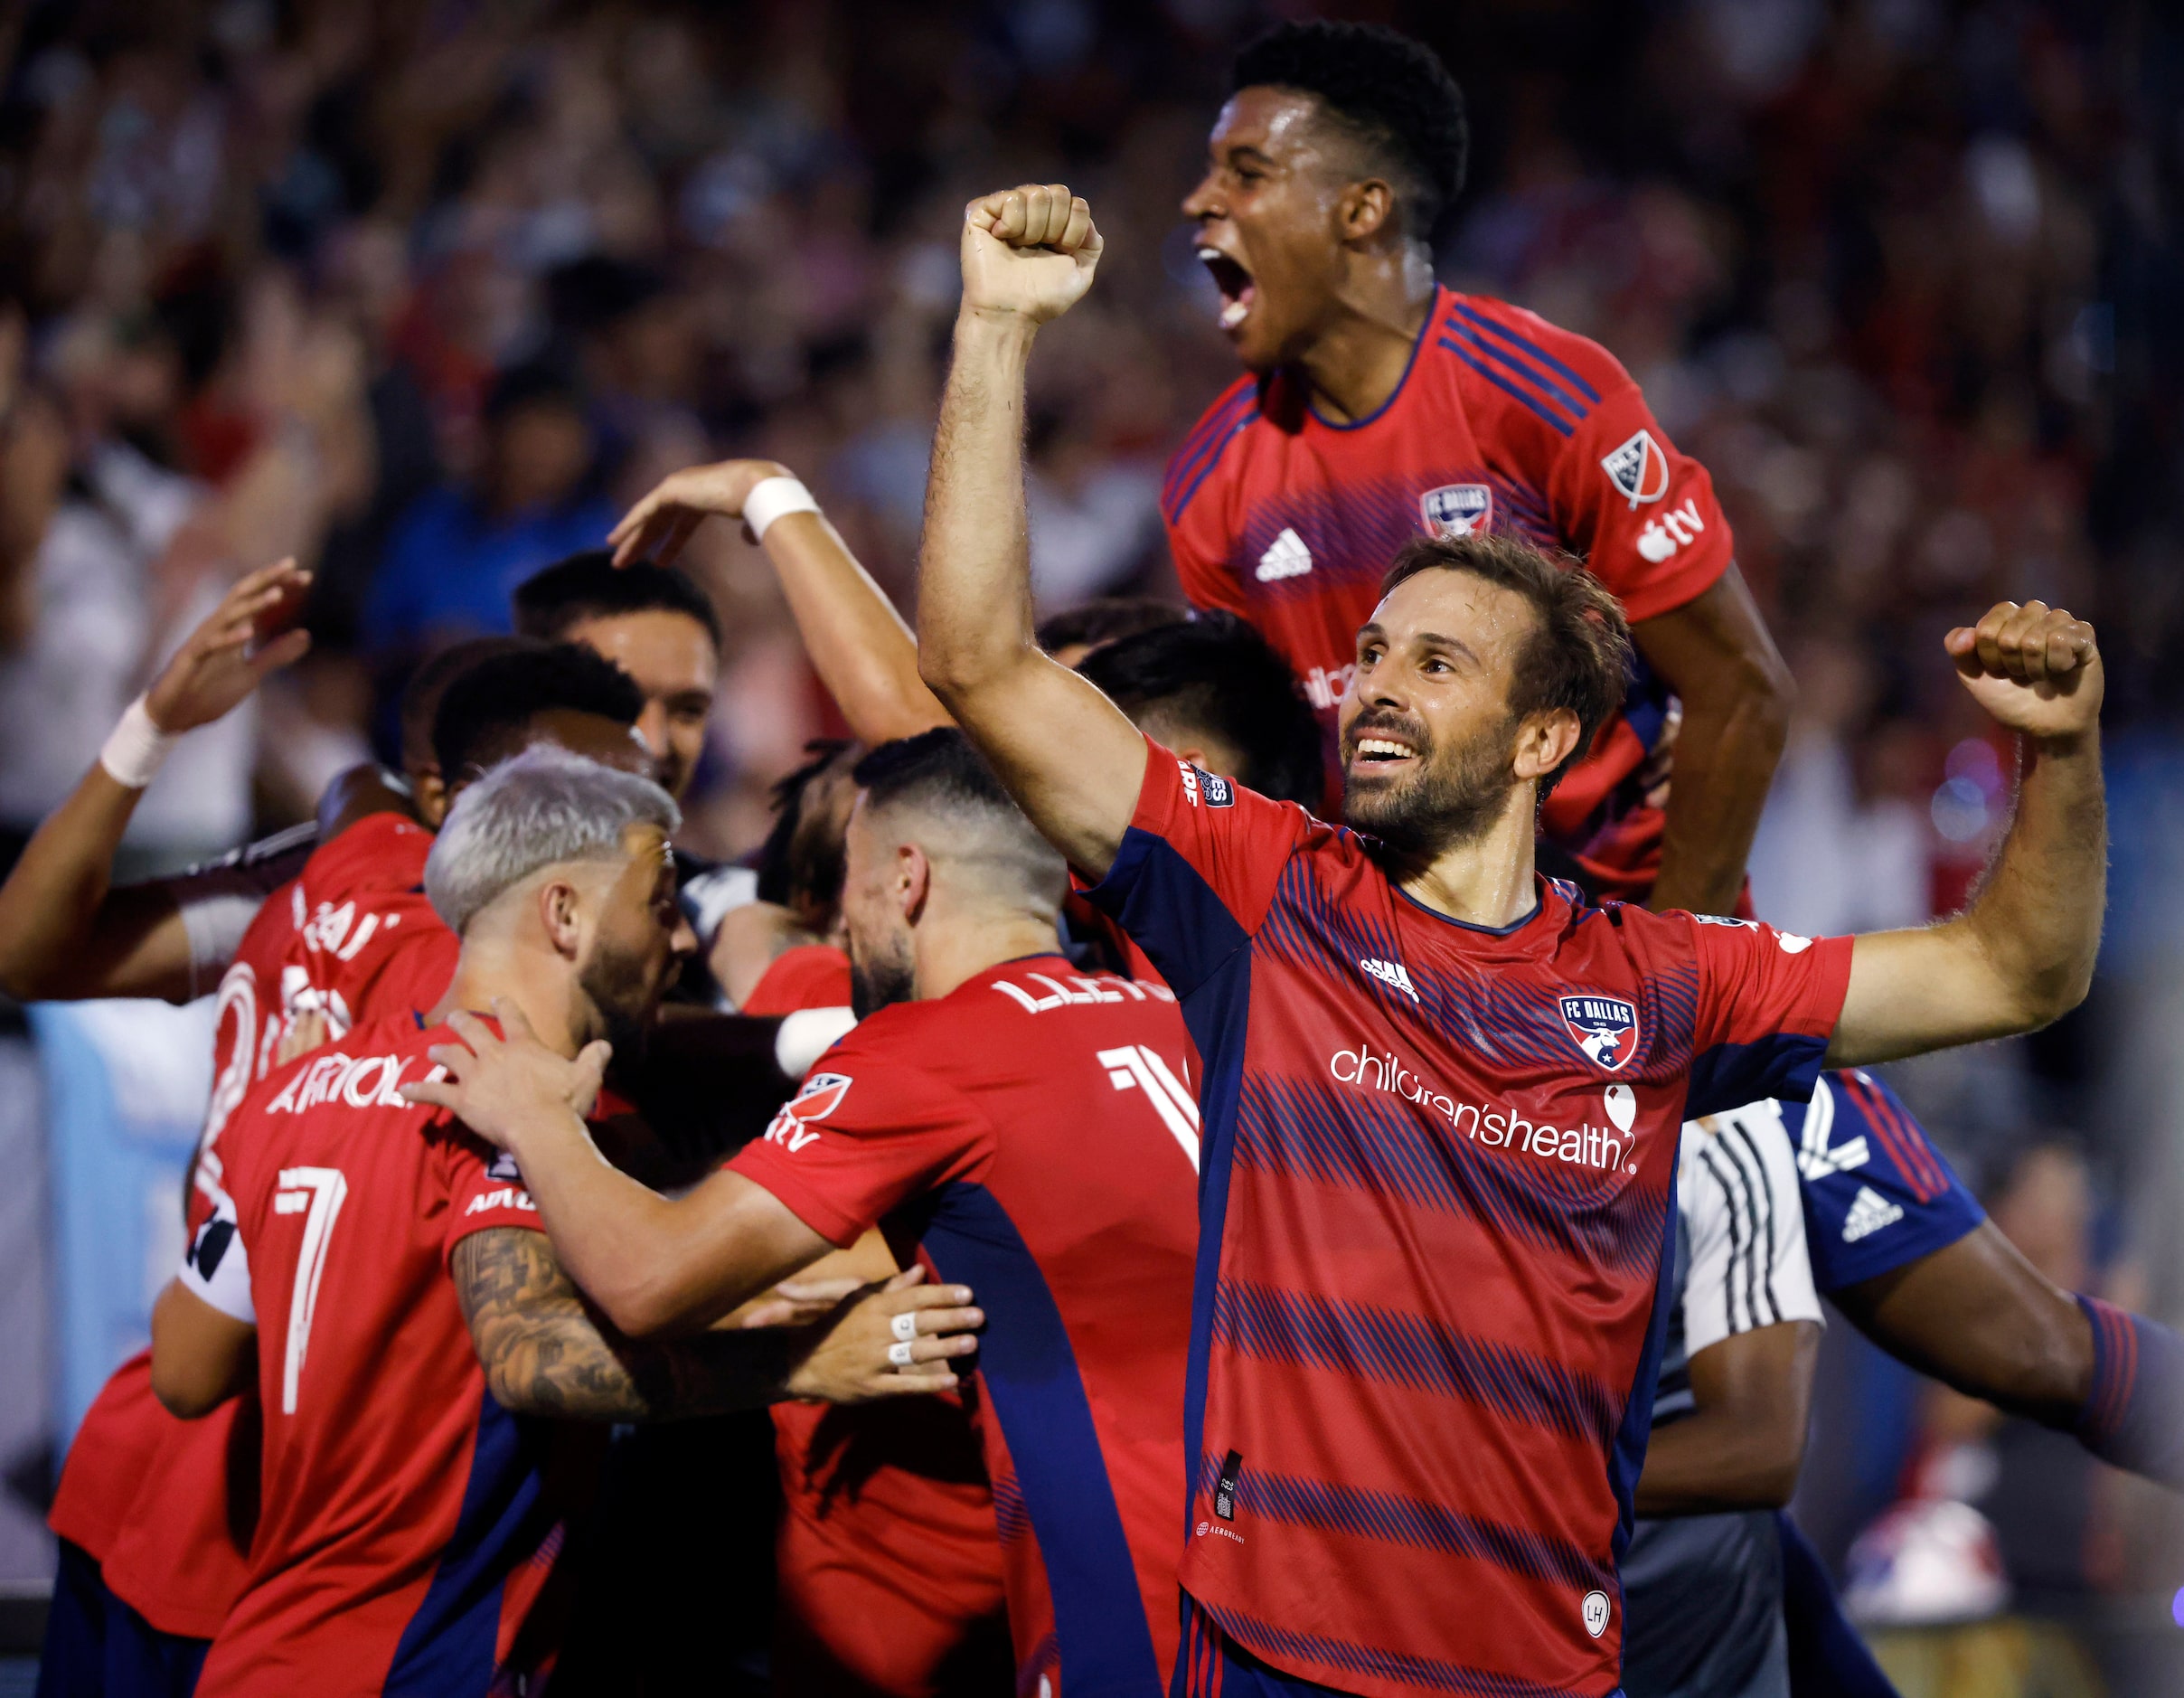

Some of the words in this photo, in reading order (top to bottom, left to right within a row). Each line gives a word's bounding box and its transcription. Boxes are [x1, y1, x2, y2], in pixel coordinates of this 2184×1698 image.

[1662, 498, 1705, 545] tv
[1566, 1001, 1581, 1018] FC
[1584, 1001, 1631, 1024] DALLAS
[275, 1166, 348, 1415] 7
[1210, 1526, 1245, 1544] AEROREADY
[1587, 1605, 1603, 1623] LH
